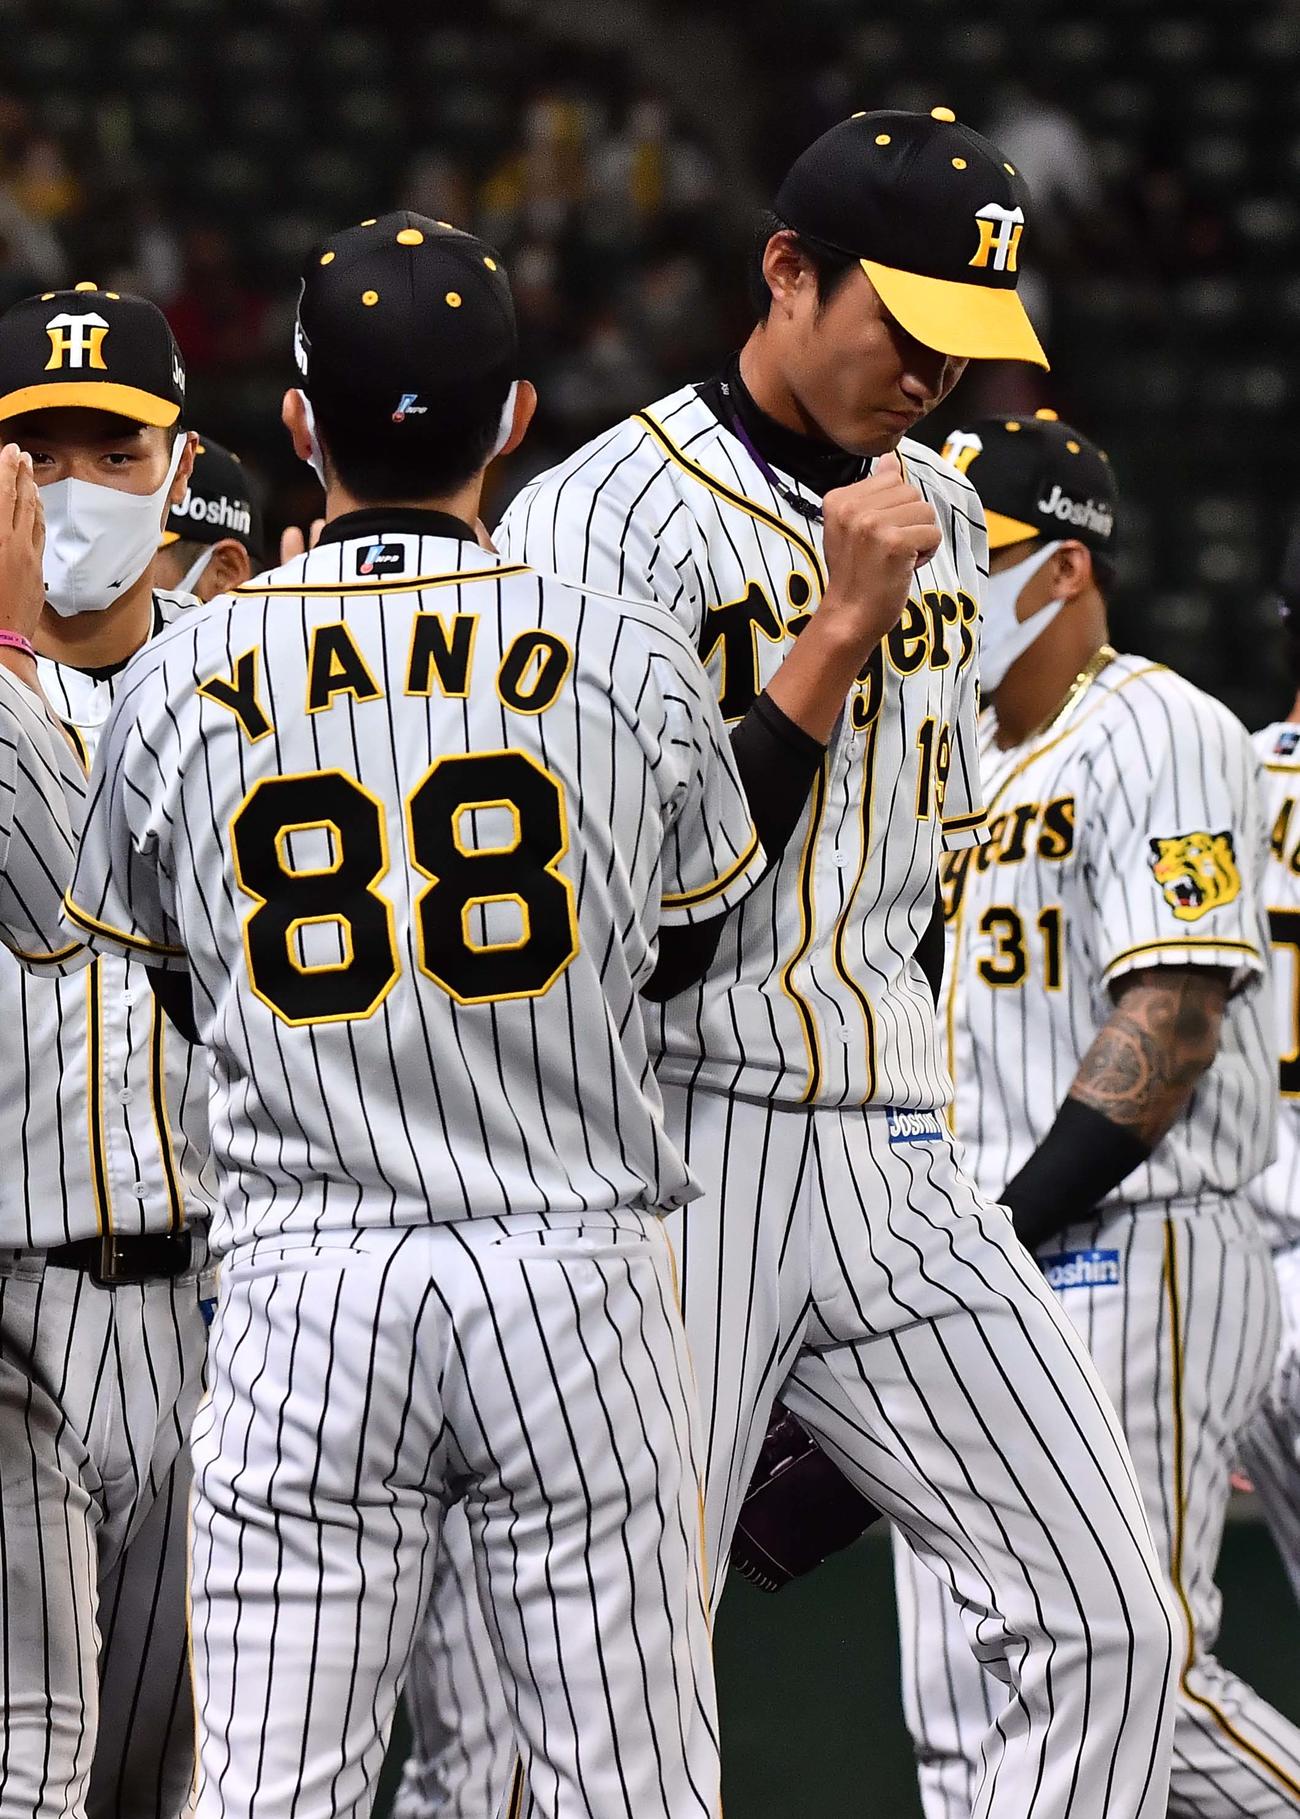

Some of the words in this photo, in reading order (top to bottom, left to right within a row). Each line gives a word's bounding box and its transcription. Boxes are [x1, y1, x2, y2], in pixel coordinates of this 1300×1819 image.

[171, 487, 250, 535] Joshin
[196, 611, 573, 745] YANO
[915, 715, 951, 823] 19
[228, 748, 580, 1028] 88
[976, 905, 1064, 993] 31
[1046, 1252, 1118, 1288] oshin
